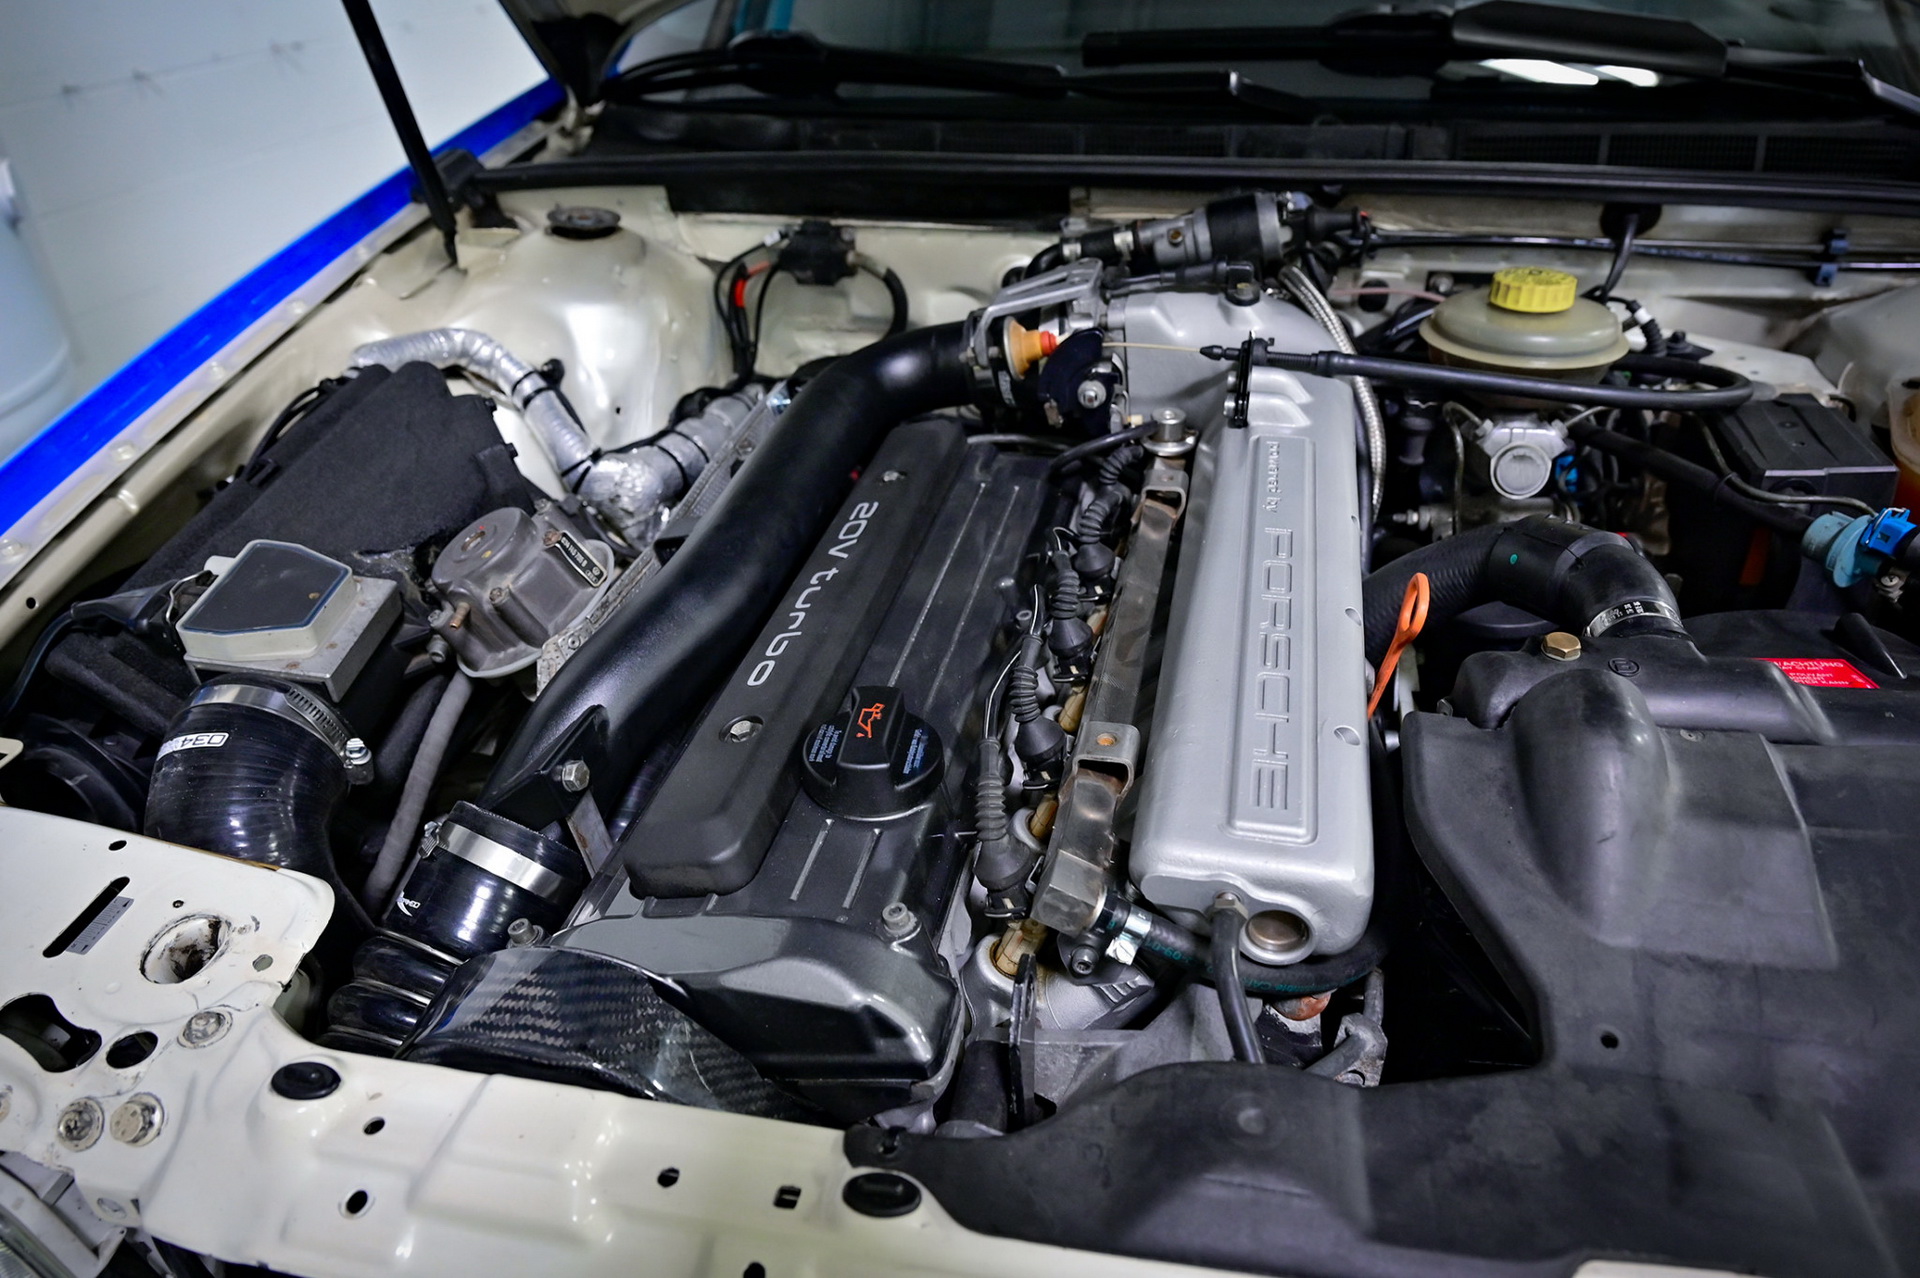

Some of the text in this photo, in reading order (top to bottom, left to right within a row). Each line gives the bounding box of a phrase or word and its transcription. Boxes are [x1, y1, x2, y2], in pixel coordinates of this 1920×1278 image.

[1262, 441, 1282, 513] powered by
[828, 501, 879, 559] 20V
[747, 567, 839, 686] turbo
[1250, 527, 1293, 811] PORSCHE
[180, 734, 227, 748] 034
